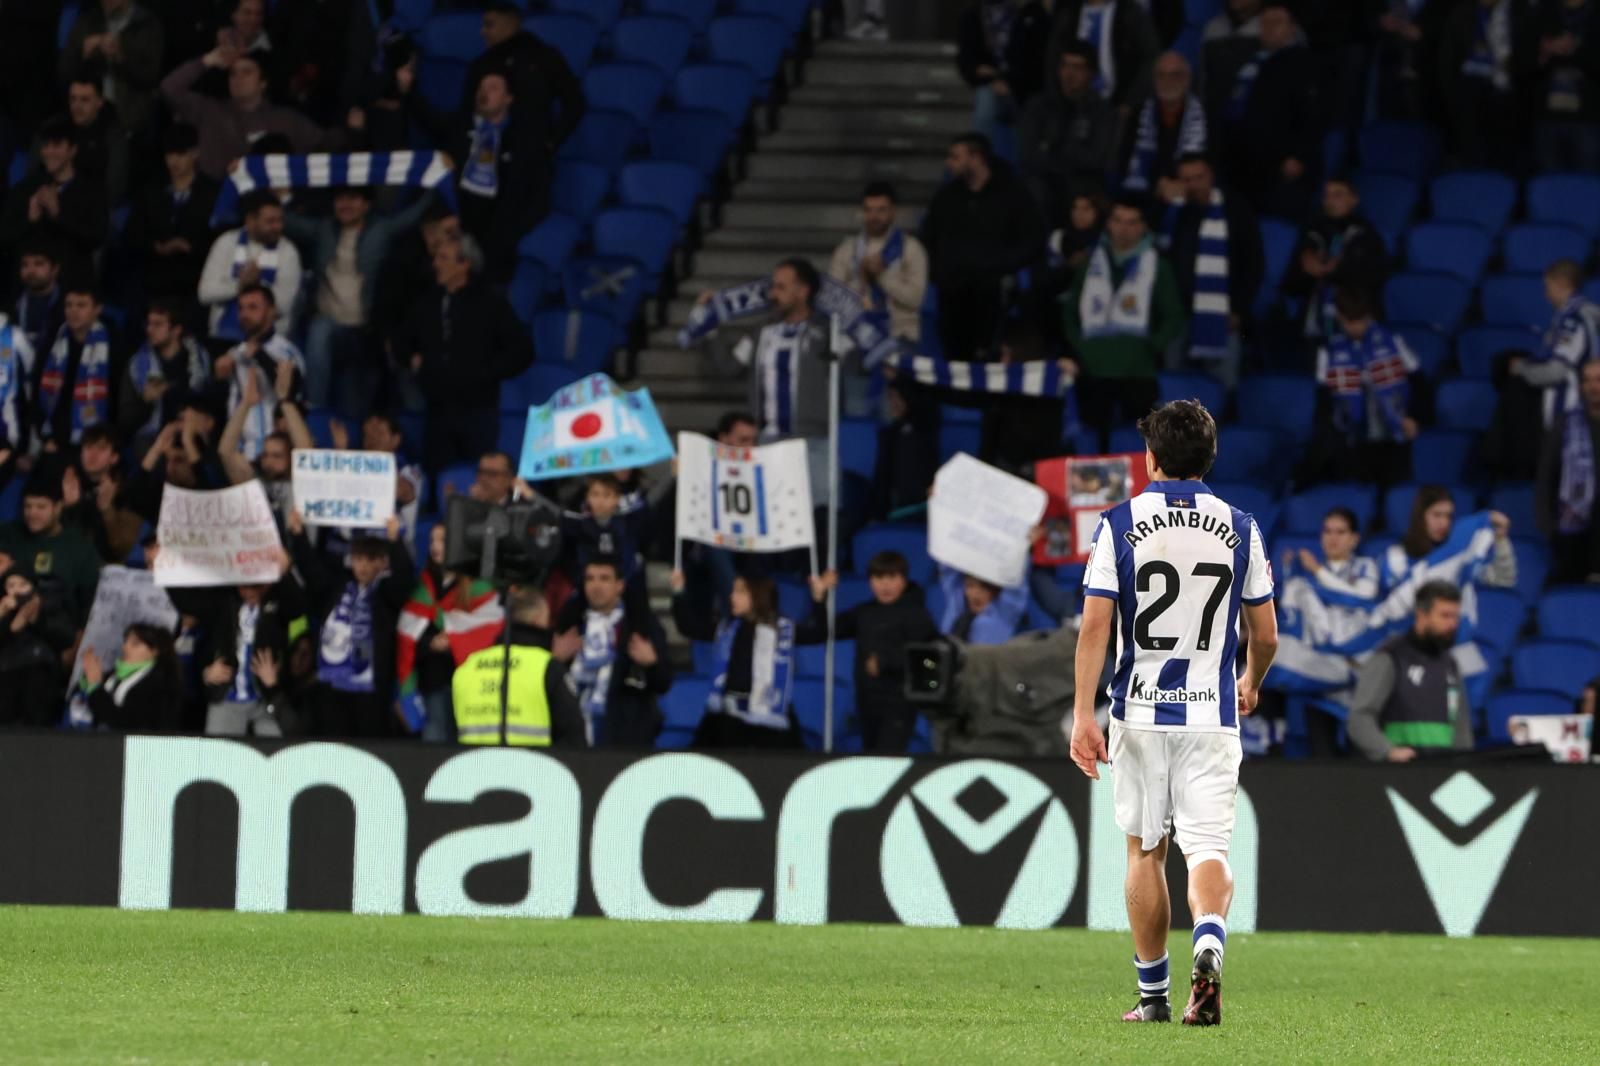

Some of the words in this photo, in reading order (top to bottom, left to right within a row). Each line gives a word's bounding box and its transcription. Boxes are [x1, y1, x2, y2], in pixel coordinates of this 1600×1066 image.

[719, 482, 752, 515] 10
[1124, 511, 1241, 550] ARAMBURU
[1134, 560, 1234, 651] 27
